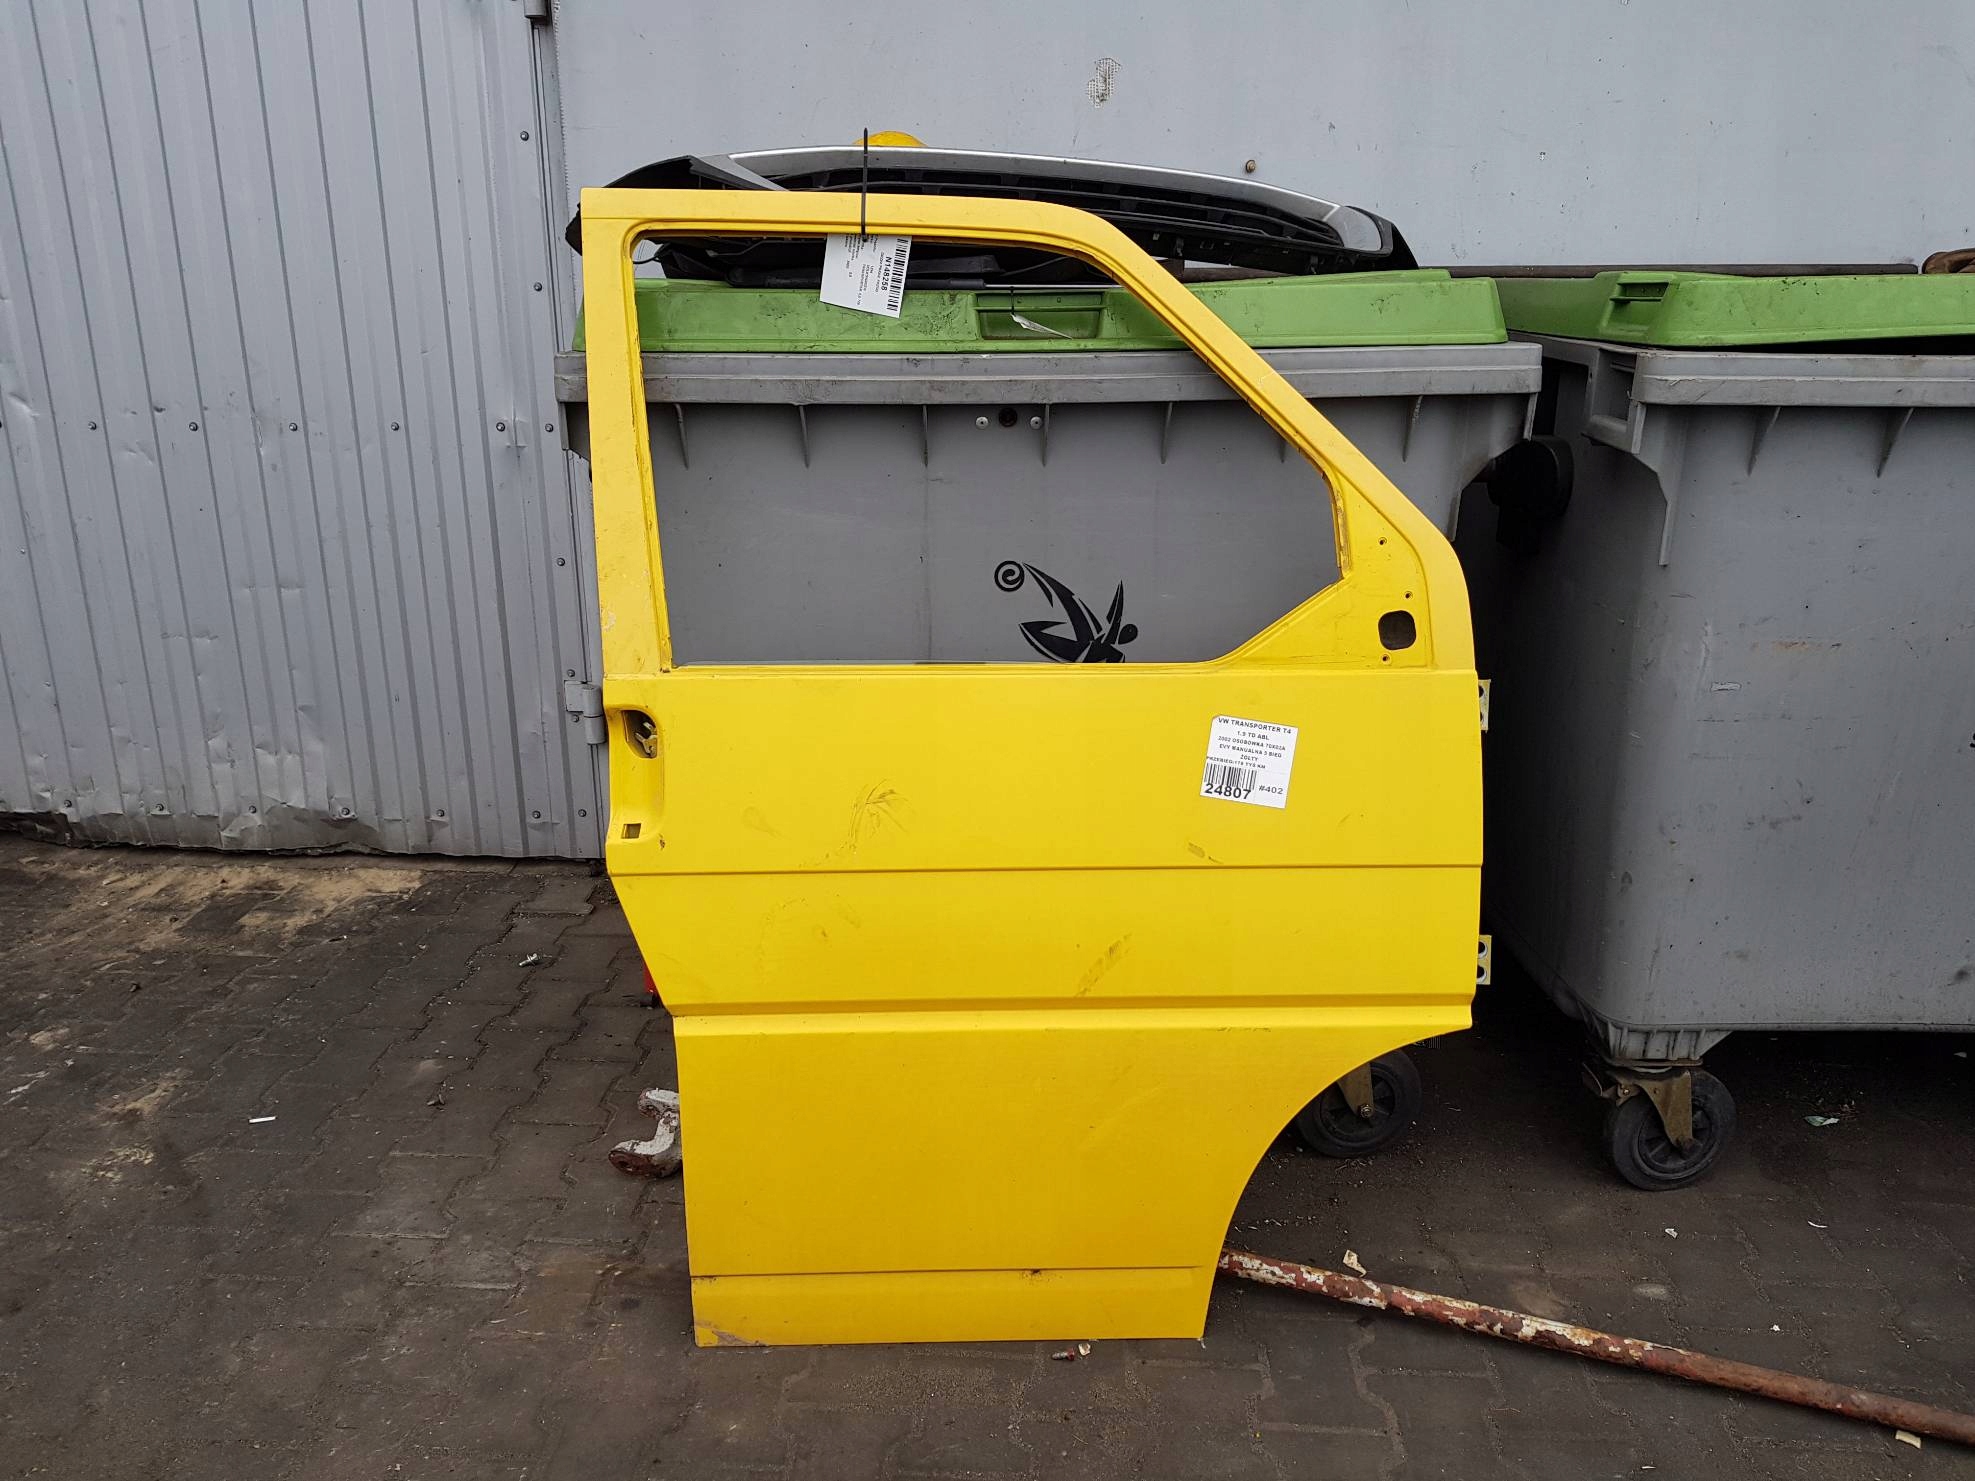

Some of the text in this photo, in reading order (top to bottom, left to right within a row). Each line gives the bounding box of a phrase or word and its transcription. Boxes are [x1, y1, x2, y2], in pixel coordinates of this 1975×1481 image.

[881, 256, 891, 291] N148258
[1231, 720, 1281, 732] TRANSPORTER
[1205, 784, 1251, 799] 24807
[1259, 785, 1283, 794] #402
